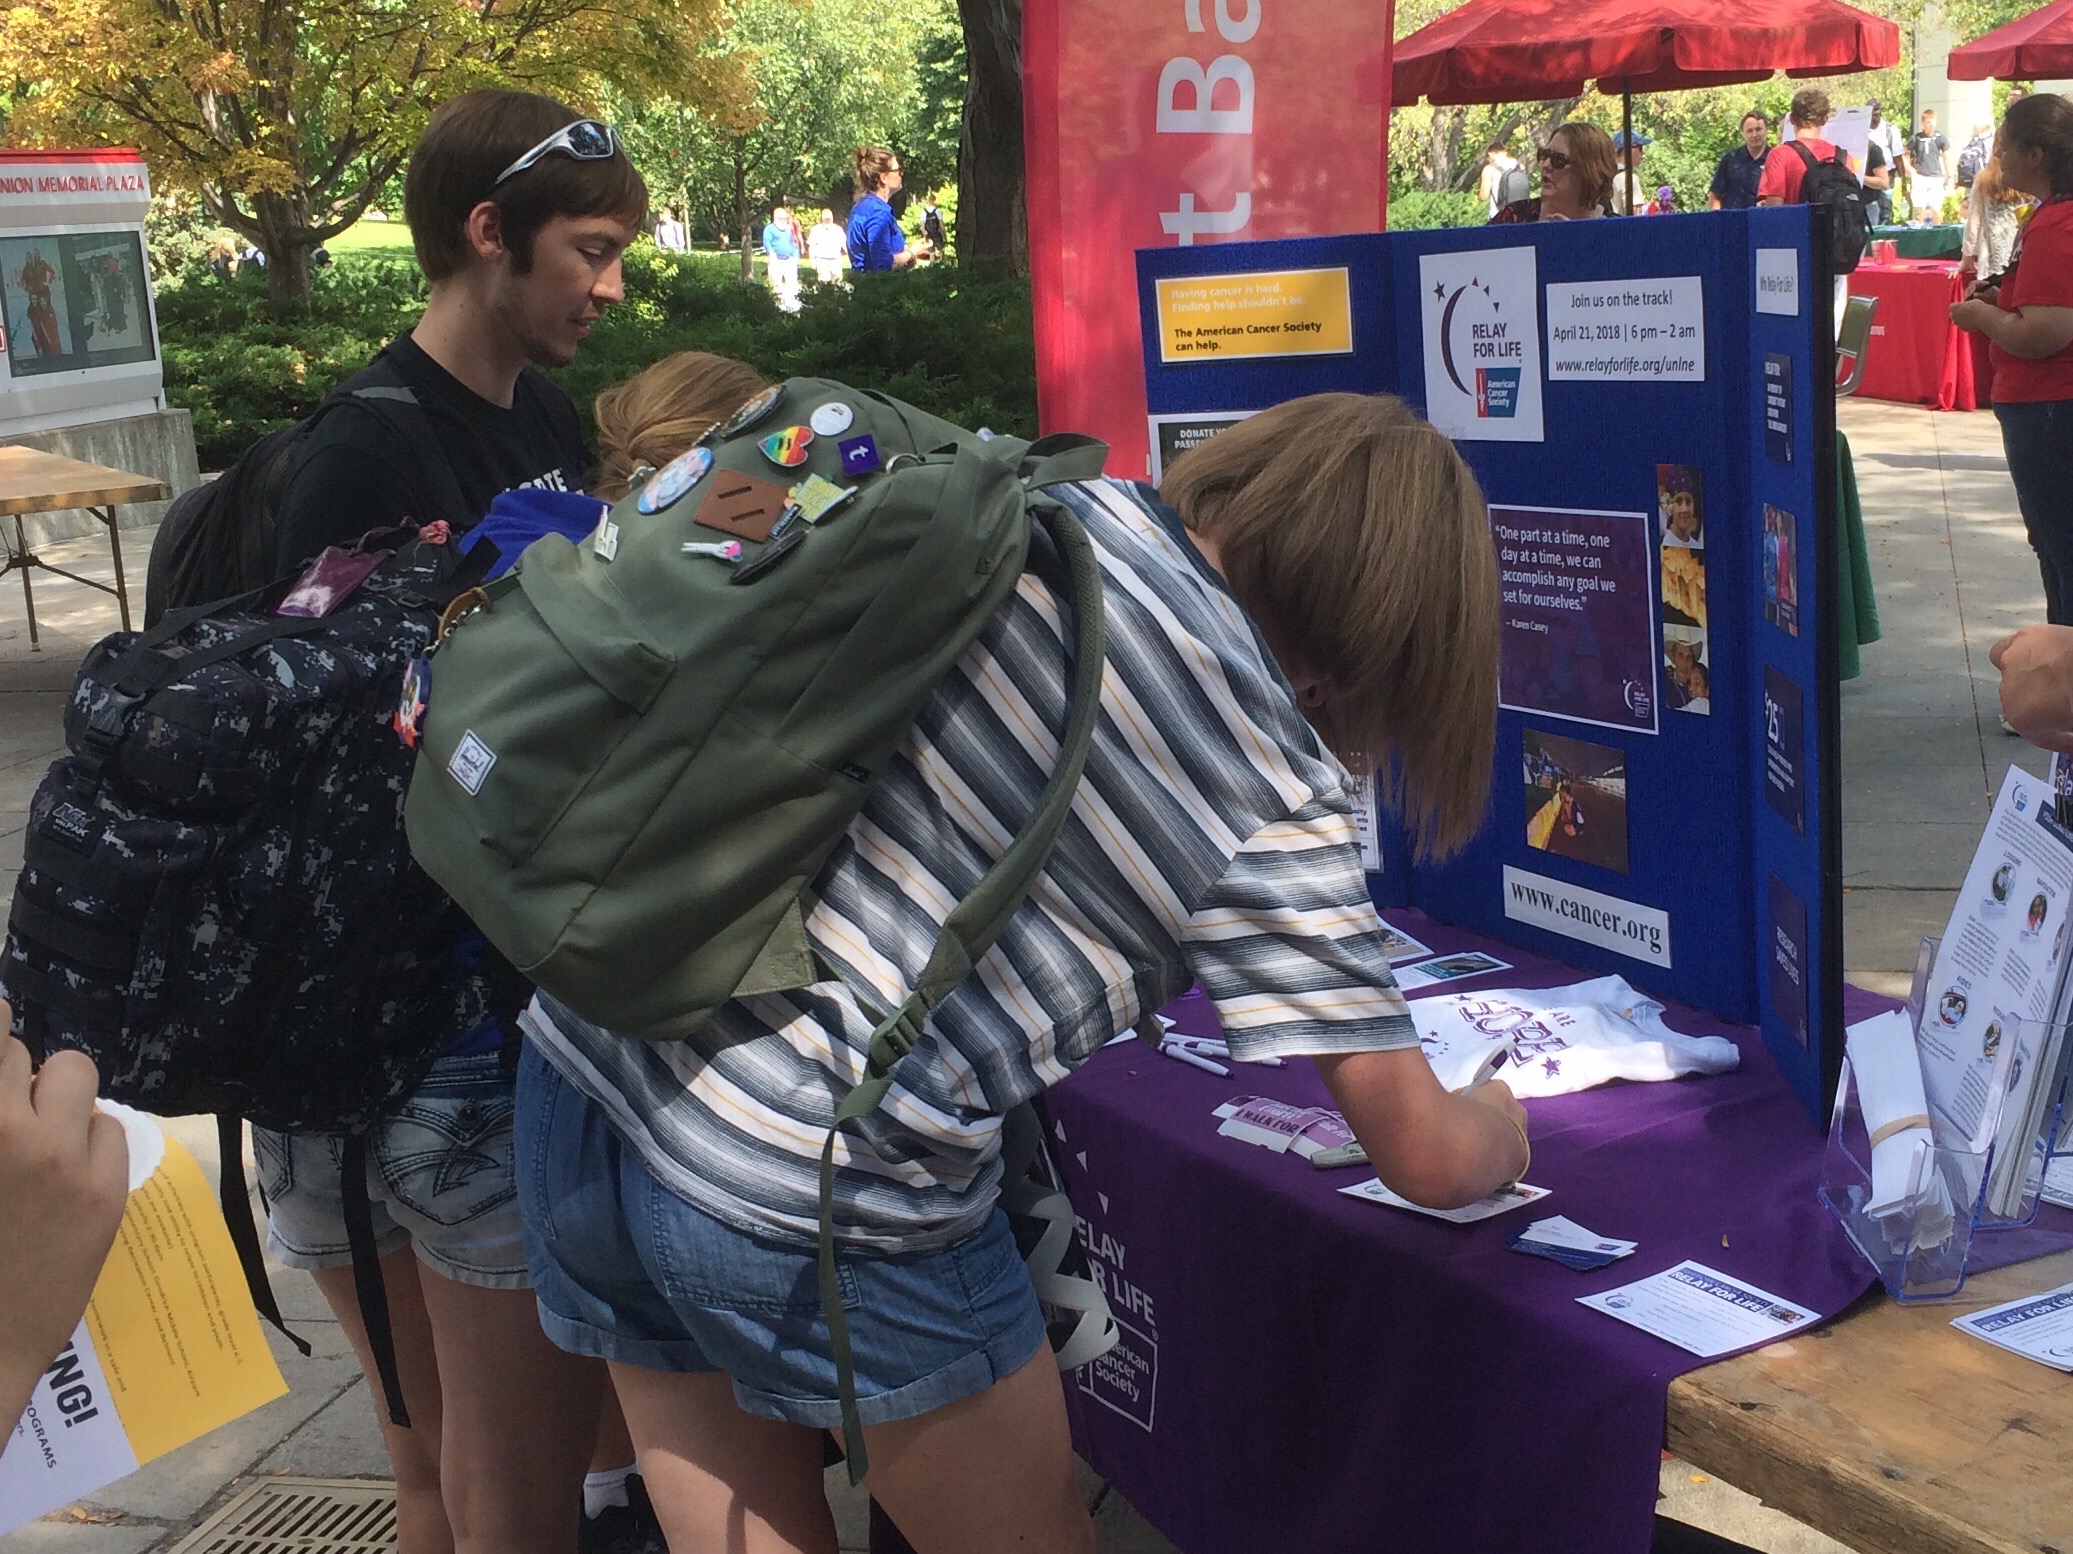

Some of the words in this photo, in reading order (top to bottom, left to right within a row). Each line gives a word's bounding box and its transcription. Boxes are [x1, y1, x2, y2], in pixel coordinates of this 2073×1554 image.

[38, 175, 104, 192] MEMORIAL
[105, 175, 145, 191] PLAZA
[1171, 287, 1207, 300] Having
[1210, 287, 1242, 297] cancer
[1245, 286, 1254, 295] is
[1256, 282, 1282, 294] hard.
[1571, 294, 1590, 308] Join
[1593, 299, 1604, 307] us
[1607, 298, 1620, 307] on
[1623, 291, 1640, 306] the
[1642, 289, 1673, 305] track!
[1172, 300, 1211, 314] Finding
[1213, 298, 1236, 312] help
[1175, 328, 1193, 338] The
[1196, 326, 1244, 337] American
[1247, 323, 1281, 334] Cancer
[1284, 321, 1322, 333] Society
[1472, 322, 1507, 339] RELAY
[1553, 326, 1576, 343] April
[1579, 326, 1594, 342] 21,
[1596, 325, 1620, 340] 2018
[1631, 324, 1638, 339] 6
[1641, 328, 1657, 342] pm
[1669, 323, 1676, 338] 2
[1679, 326, 1695, 338] am
[1176, 343, 1194, 351] can
[1196, 340, 1221, 352] help.
[1473, 342, 1496, 358] FOR
[1499, 341, 1522, 357] LIFE
[1180, 428, 1214, 438] DONATE
[1521, 529, 1540, 543] part
[1542, 531, 1552, 543] at
[1554, 534, 1560, 543] a
[1562, 529, 1588, 549] time,
[1590, 535, 1610, 548] one
[1501, 547, 1518, 564] day
[1520, 550, 1531, 563] at
[1532, 553, 1538, 563] a
[1539, 549, 1565, 568] time,
[1566, 555, 1581, 567] we
[1583, 556, 1601, 569] can
[1502, 569, 1555, 588] accomplish
[1557, 575, 1574, 592] any
[1577, 576, 1599, 594] goal
[1600, 580, 1616, 593] we
[1503, 590, 1518, 603] set
[1519, 589, 1532, 605] for
[1512, 619, 1530, 631] Karen
[1530, 620, 1549, 635] Casey
[1511, 882, 1662, 954] www.cancer.org
[1076, 1214, 1126, 1270] ELAY
[1112, 1271, 1156, 1327] LIFE
[1670, 1271, 1713, 1289] RELAY
[1708, 1286, 1737, 1301] FOR
[1734, 1297, 1764, 1312] LIFE
[1981, 1313, 2026, 1331] RELAY
[2025, 1304, 2056, 1317] FOR
[1095, 1362, 1141, 1403] Society
[27, 1400, 57, 1469] OGRAMS
